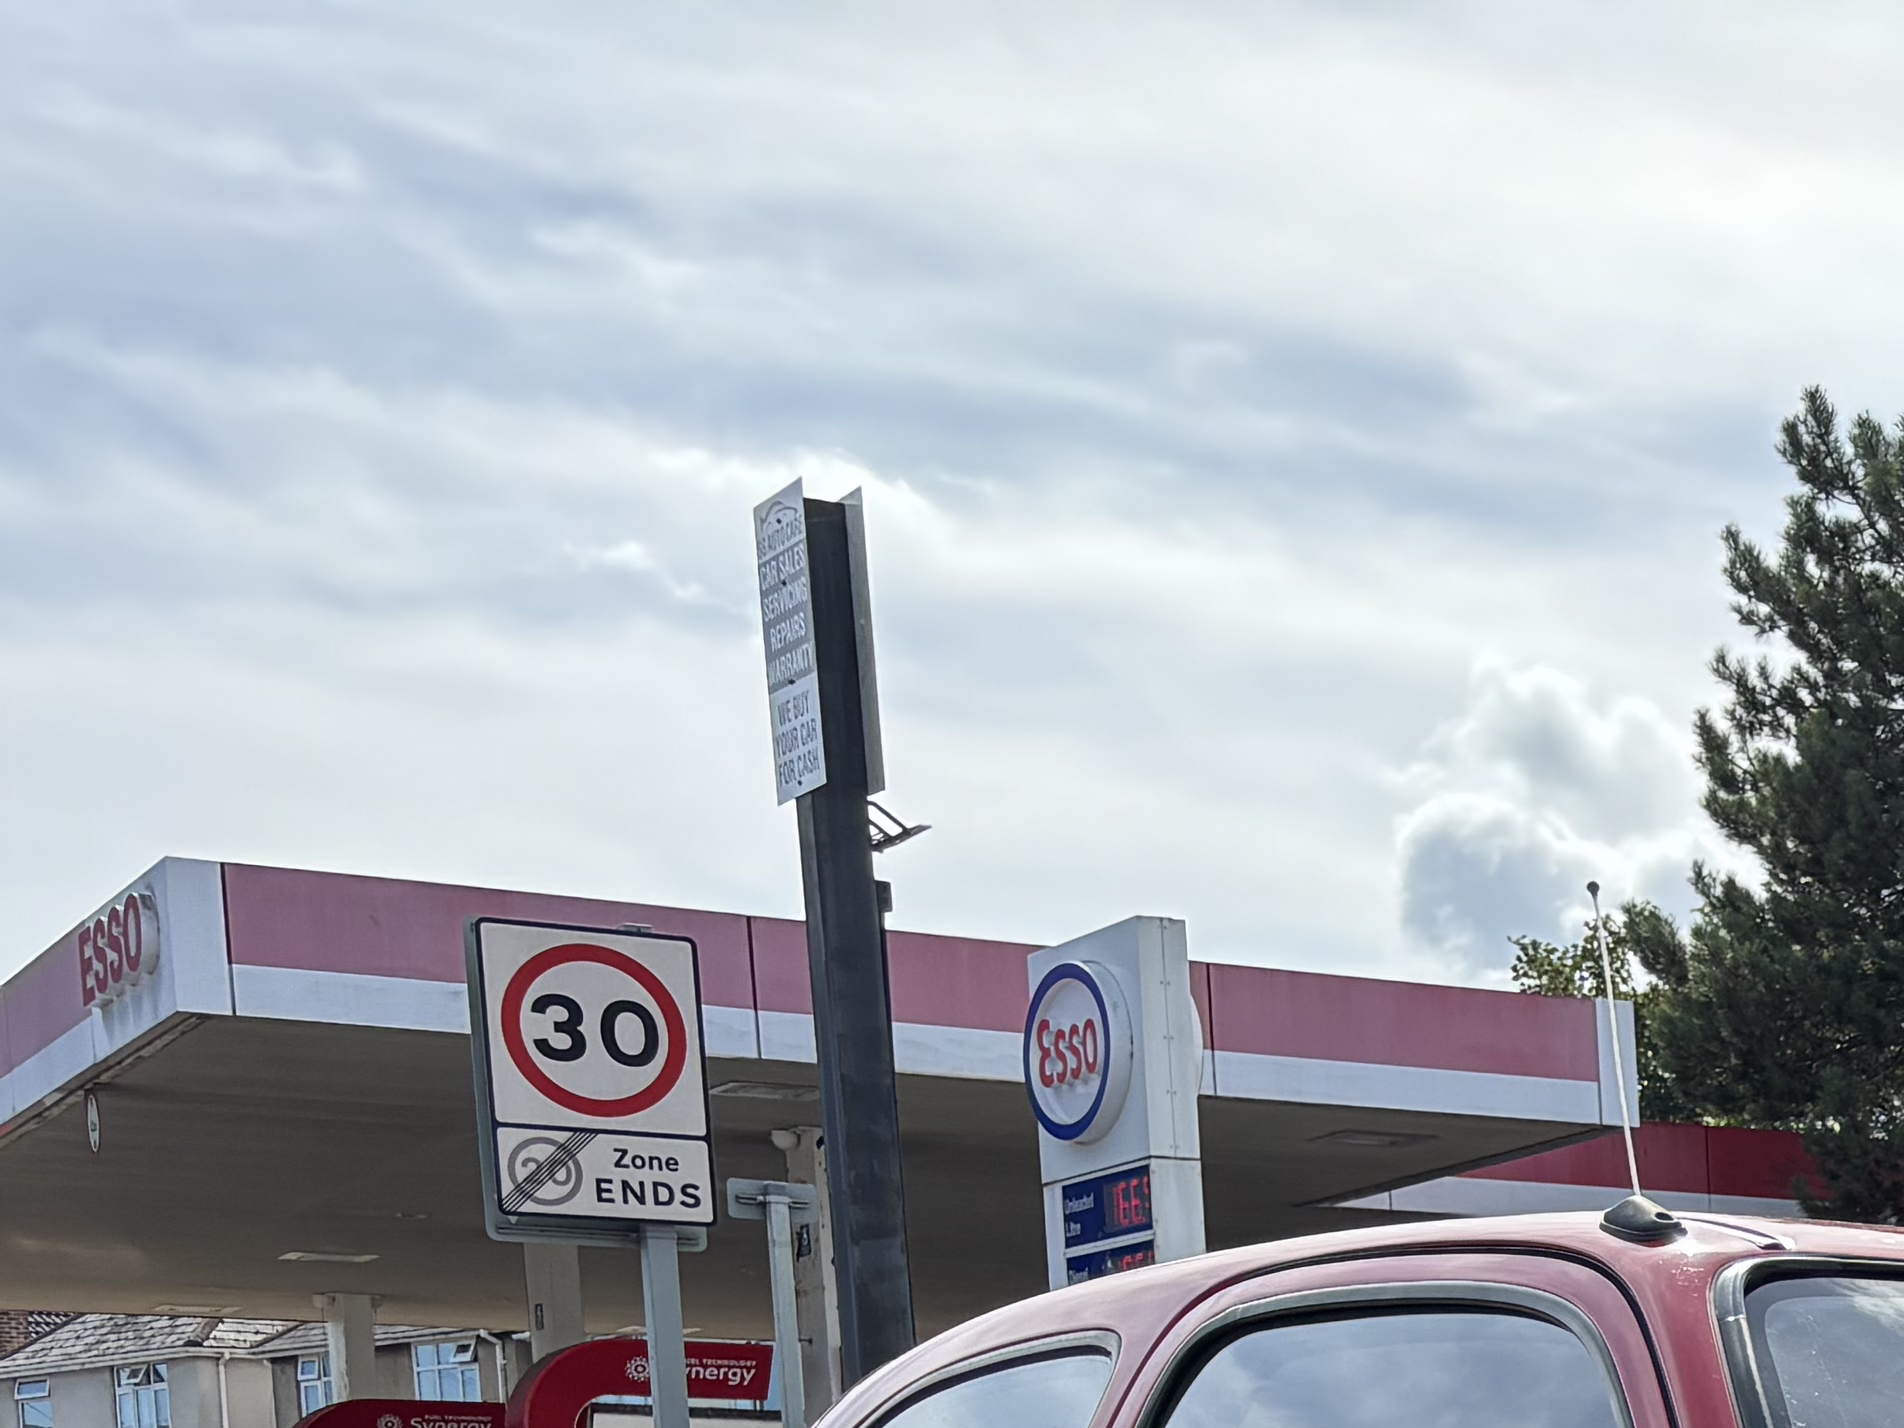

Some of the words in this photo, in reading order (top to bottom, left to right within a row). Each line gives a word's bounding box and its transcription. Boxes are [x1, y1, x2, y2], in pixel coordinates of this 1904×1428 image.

[759, 560, 779, 592] CAR
[778, 544, 806, 580] SALES
[763, 576, 808, 623] SERVICING
[770, 611, 806, 653] REPAIRS
[767, 641, 814, 686] WARRANTY
[777, 699, 792, 728] WE
[793, 688, 810, 721] BUY
[776, 726, 800, 759] YOUR
[800, 717, 818, 748] CAR
[778, 759, 797, 788] FOR
[796, 746, 820, 778] CASH
[78, 893, 142, 1007] ESSO
[530, 993, 660, 1068] 30
[612, 1147, 680, 1173] Zone
[595, 1177, 702, 1209] ENDS
